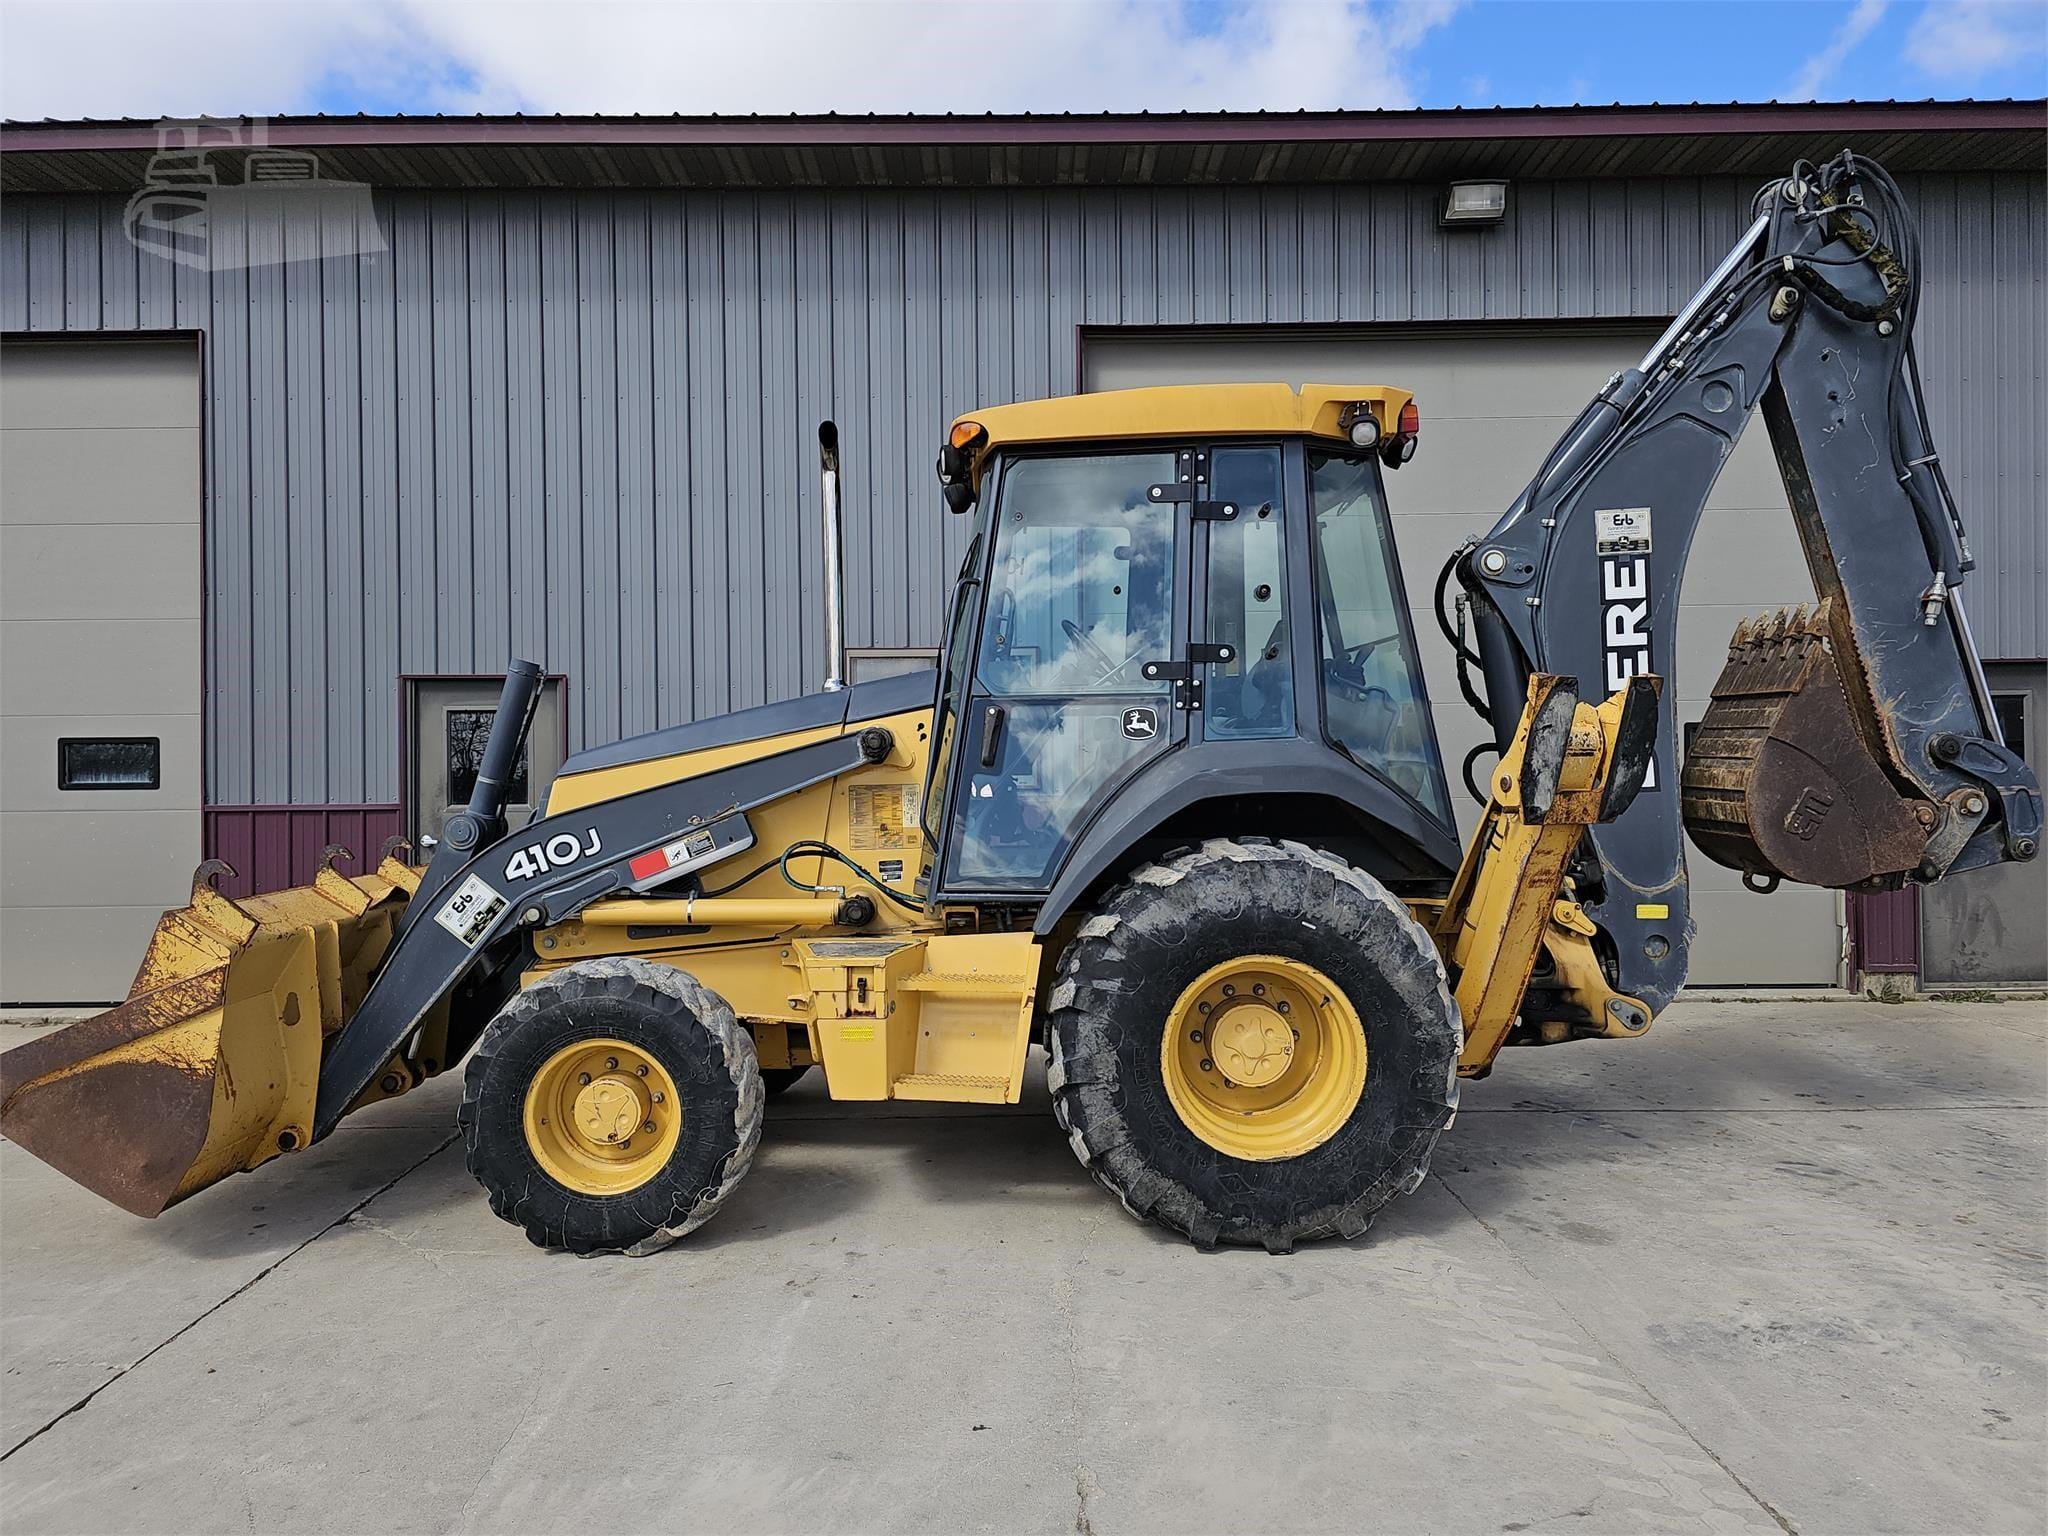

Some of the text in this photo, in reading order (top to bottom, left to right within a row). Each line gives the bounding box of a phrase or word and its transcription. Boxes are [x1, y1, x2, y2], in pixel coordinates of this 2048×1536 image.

[1613, 514, 1634, 526] Erb
[504, 827, 602, 882] 410J
[451, 895, 473, 914] Erb
